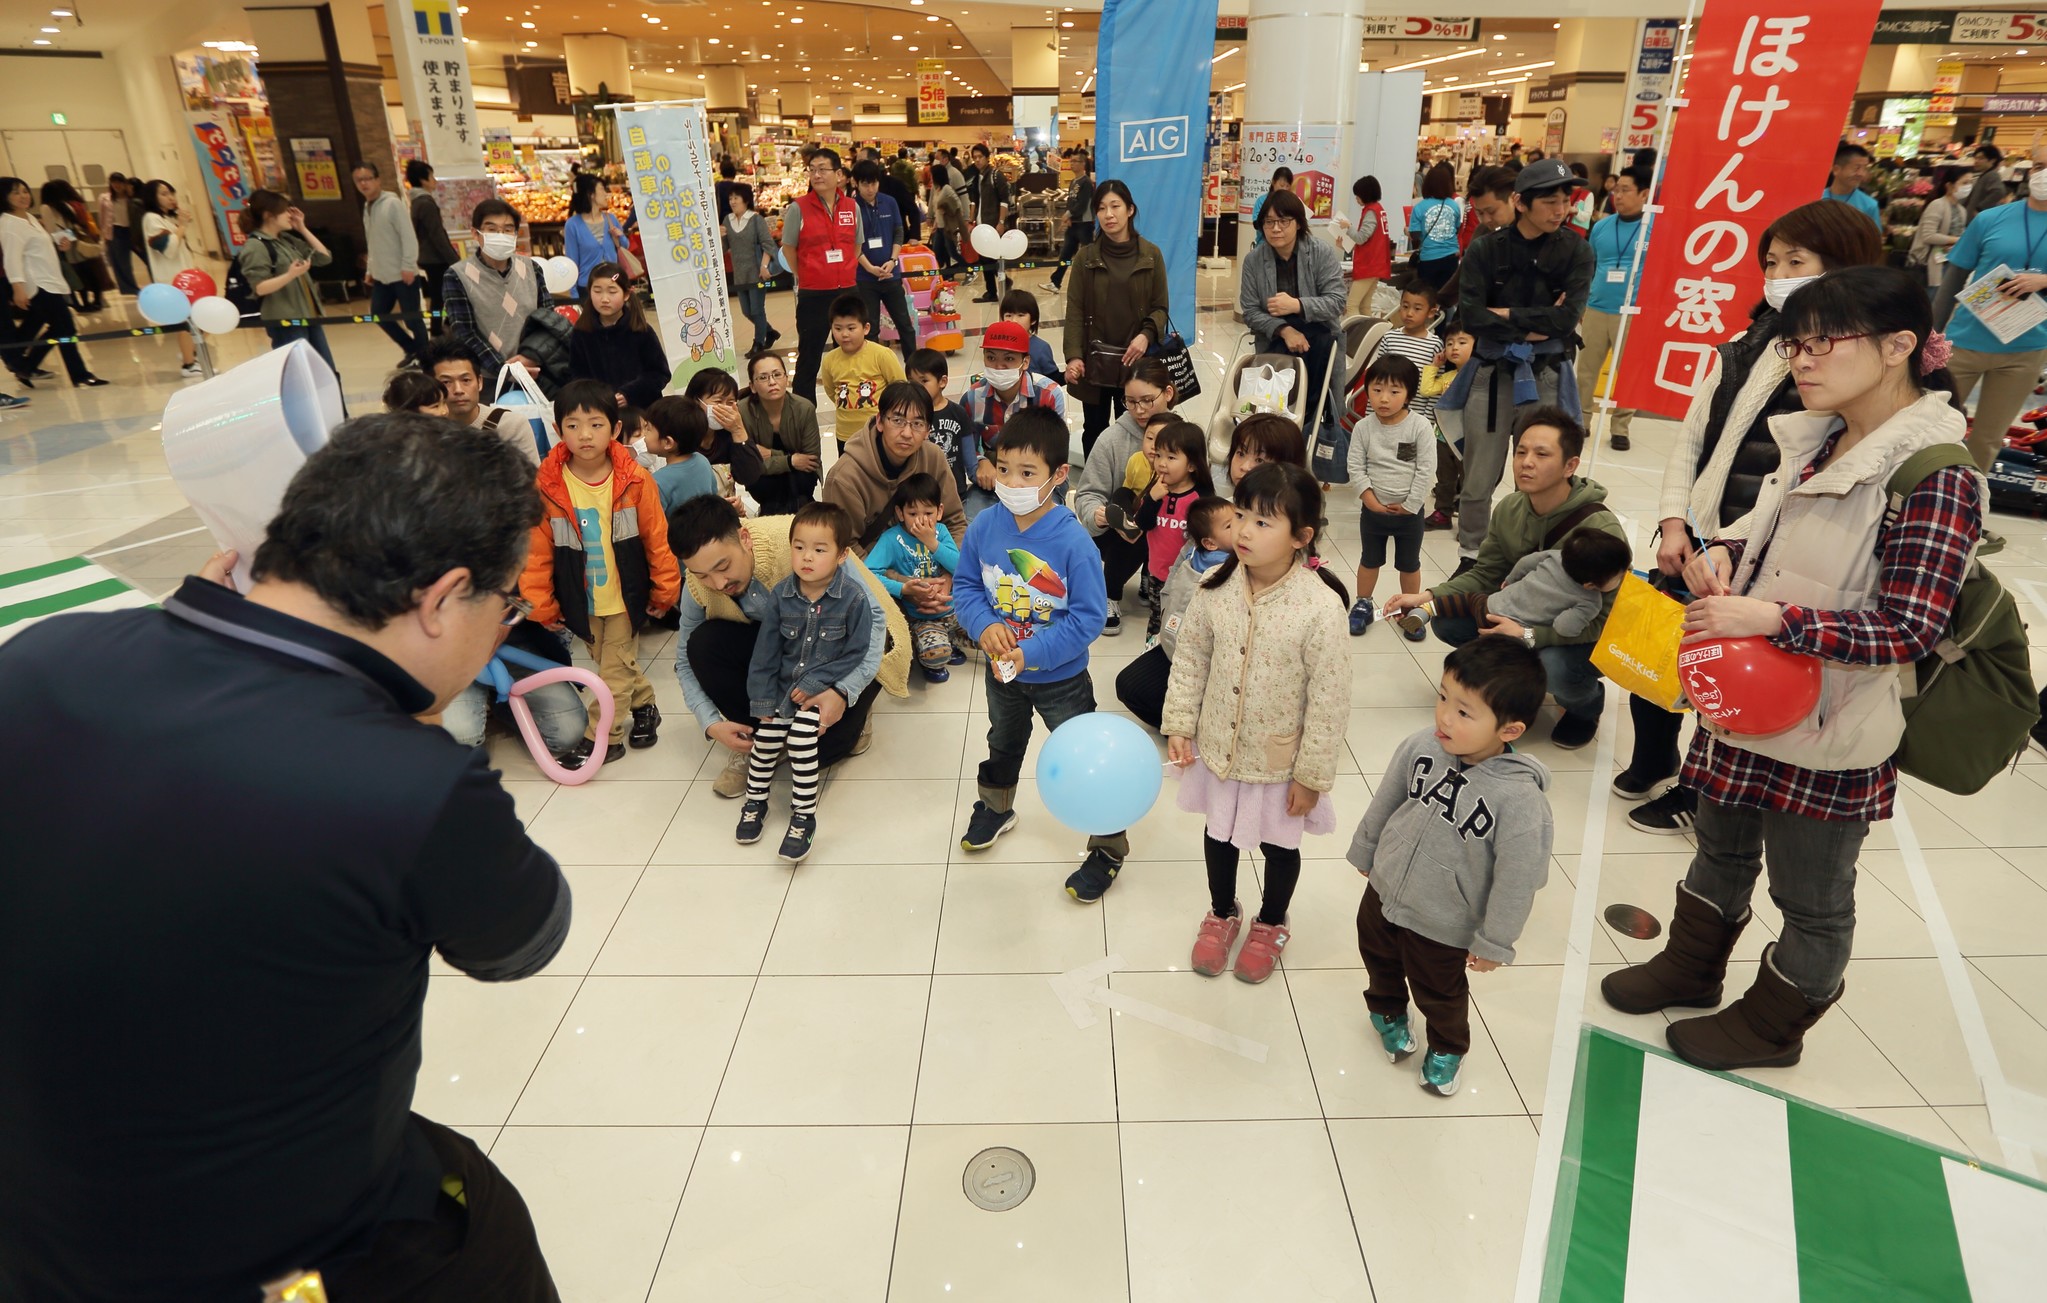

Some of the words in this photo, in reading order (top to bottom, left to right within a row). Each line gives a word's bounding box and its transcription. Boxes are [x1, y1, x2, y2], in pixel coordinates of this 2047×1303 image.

[419, 37, 455, 46] T-POINT
[1364, 24, 1396, 35] 利用で
[422, 60, 450, 131] 使えます。
[444, 60, 472, 146] 貯まります。
[920, 85, 945, 102] 5倍
[1631, 104, 1659, 130] 5
[1128, 125, 1180, 154] AIG
[1248, 131, 1299, 143] 専門店限定
[304, 172, 336, 190] 5倍
[1654, 15, 1811, 397] ほけんの窓口
[939, 418, 961, 435] POINT
[1608, 643, 1660, 682] Genki-Kids
[1408, 754, 1496, 843] GAP
